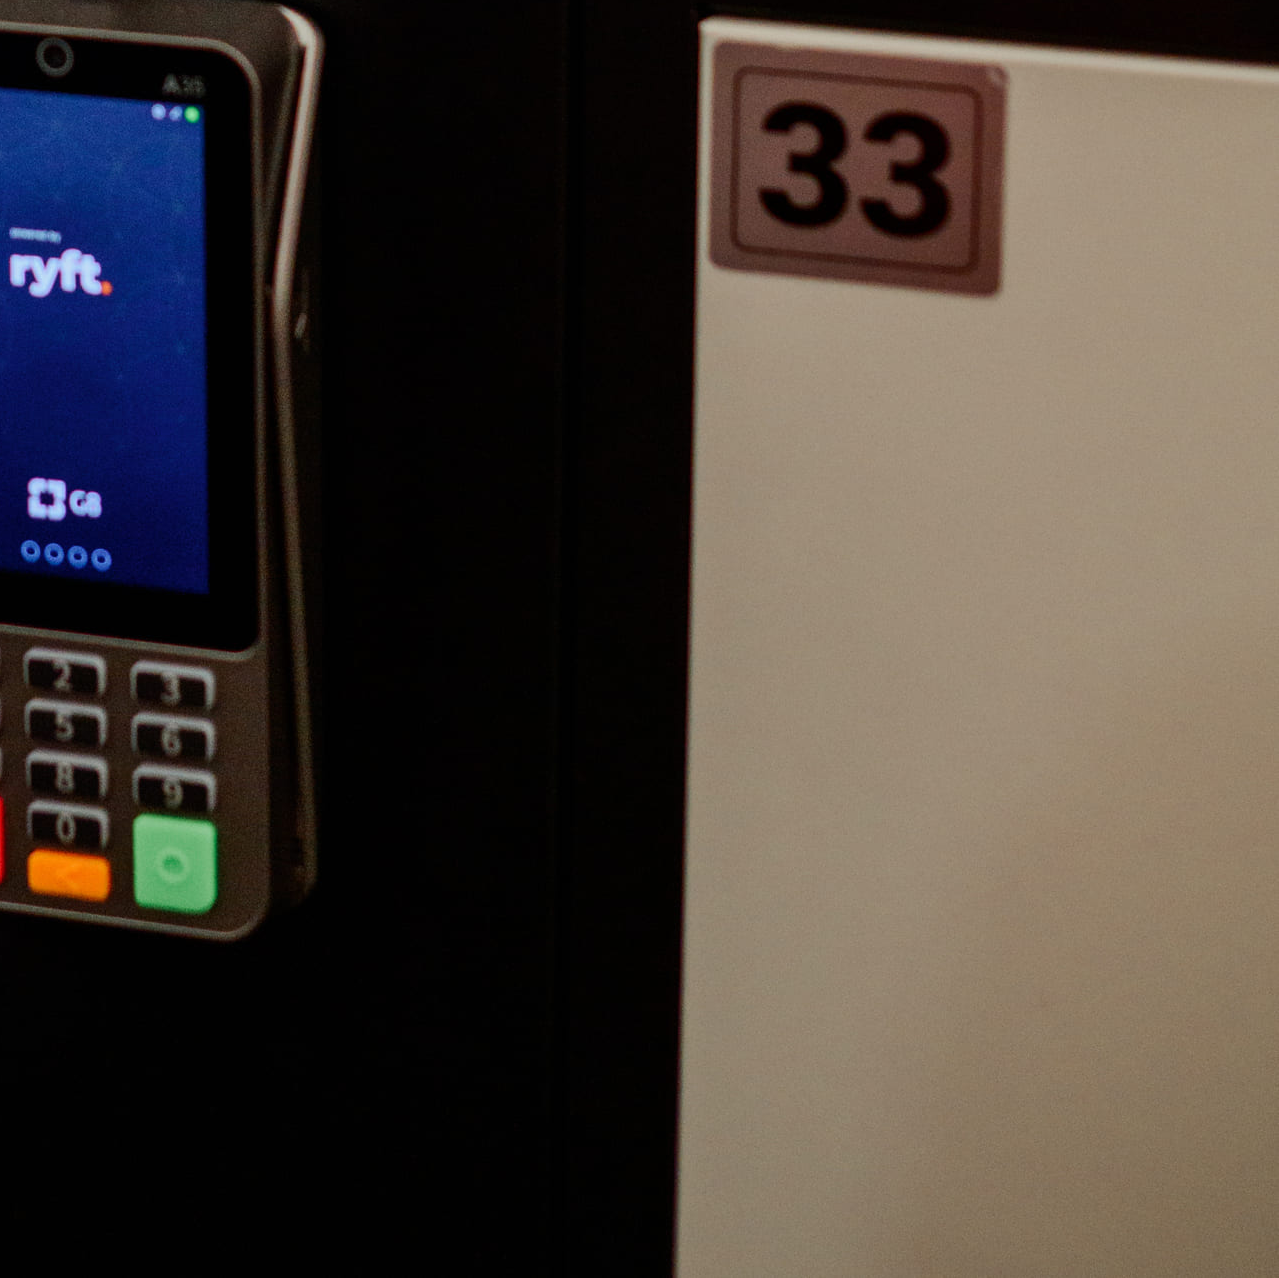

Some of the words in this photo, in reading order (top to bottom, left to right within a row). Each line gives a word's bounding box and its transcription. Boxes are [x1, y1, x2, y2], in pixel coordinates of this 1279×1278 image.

[758, 101, 950, 239] 33
[53, 662, 72, 690] 2
[162, 674, 181, 705] 3
[55, 712, 74, 741] 5
[163, 723, 182, 753] 6
[55, 762, 75, 792] 8
[164, 774, 183, 804] 9
[56, 813, 76, 843] 0
